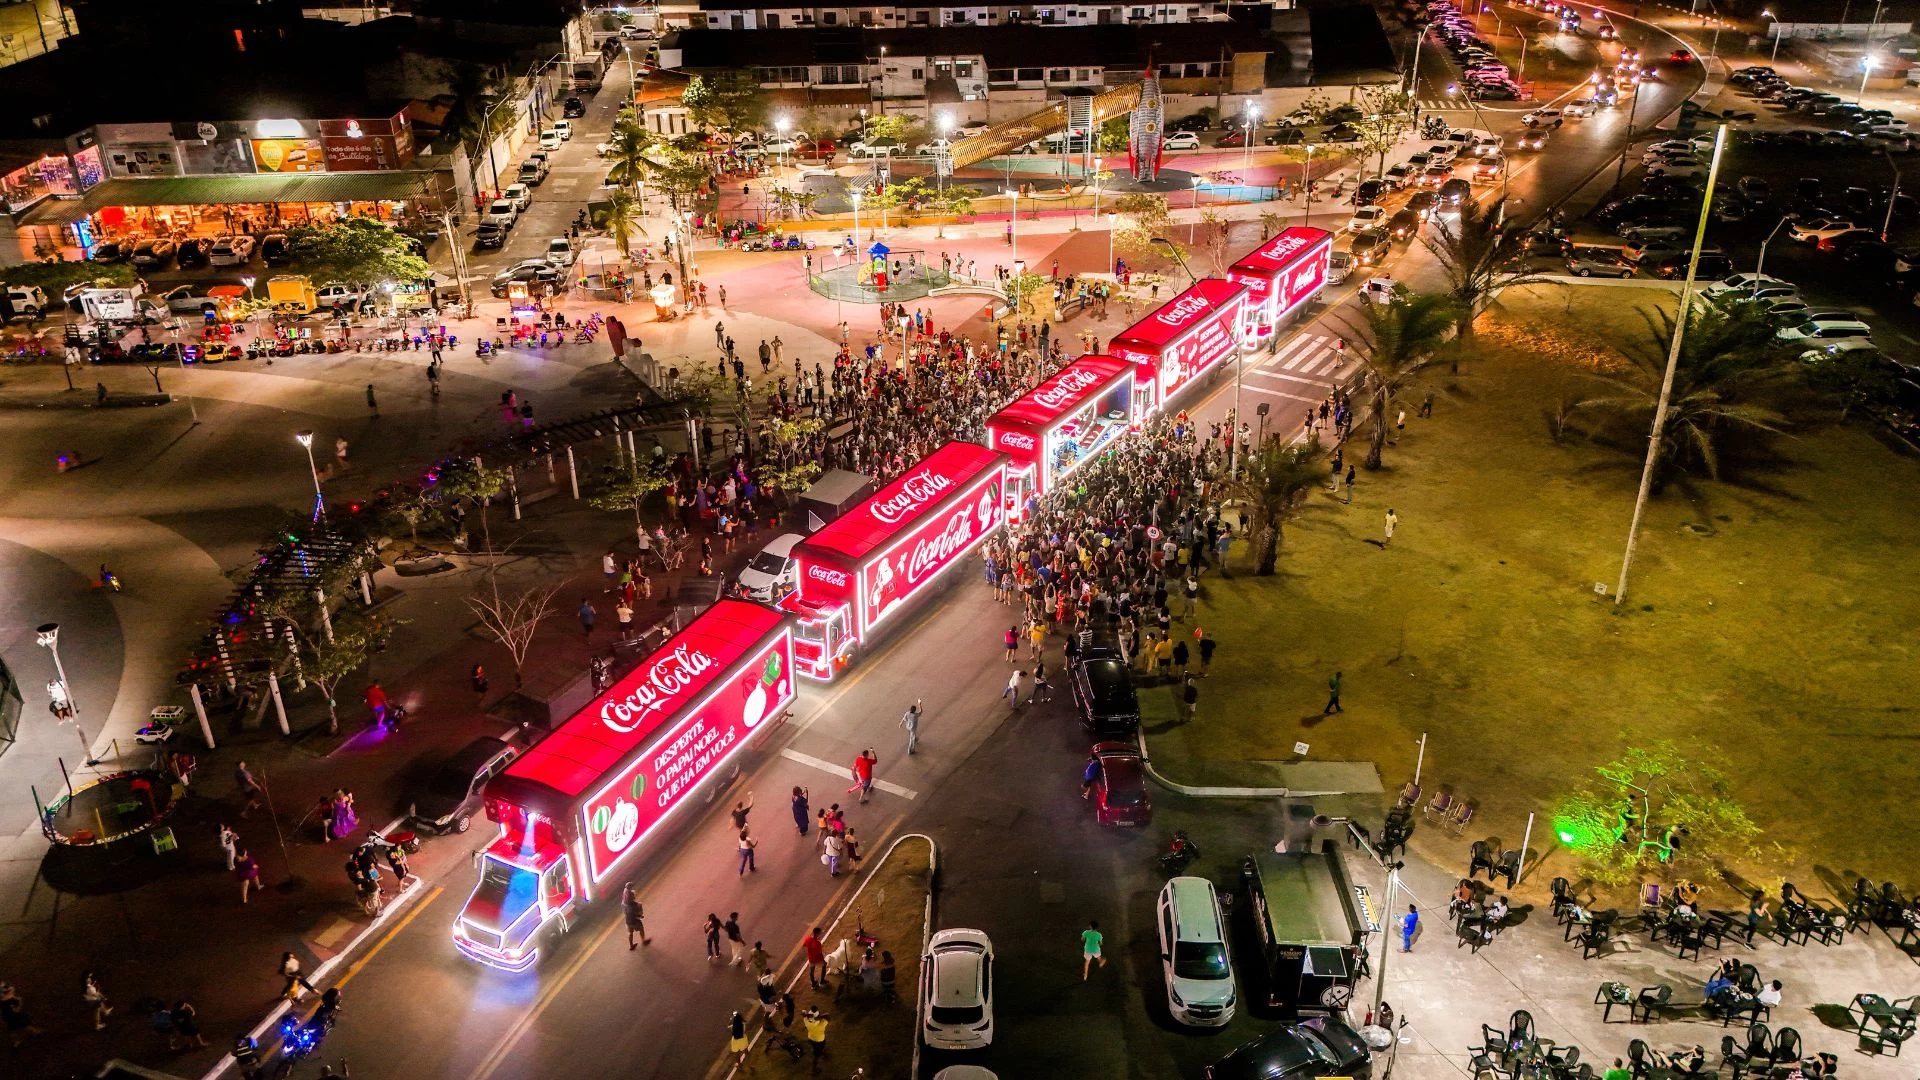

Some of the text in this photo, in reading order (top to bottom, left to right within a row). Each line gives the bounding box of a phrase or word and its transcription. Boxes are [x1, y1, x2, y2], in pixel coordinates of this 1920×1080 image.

[601, 642, 713, 733] Coca-Cola
[654, 718, 705, 773] DESPERTE
[656, 726, 720, 789] O PAPAI NOEL
[657, 724, 736, 808] QUE HÁ EM VOCÊ
